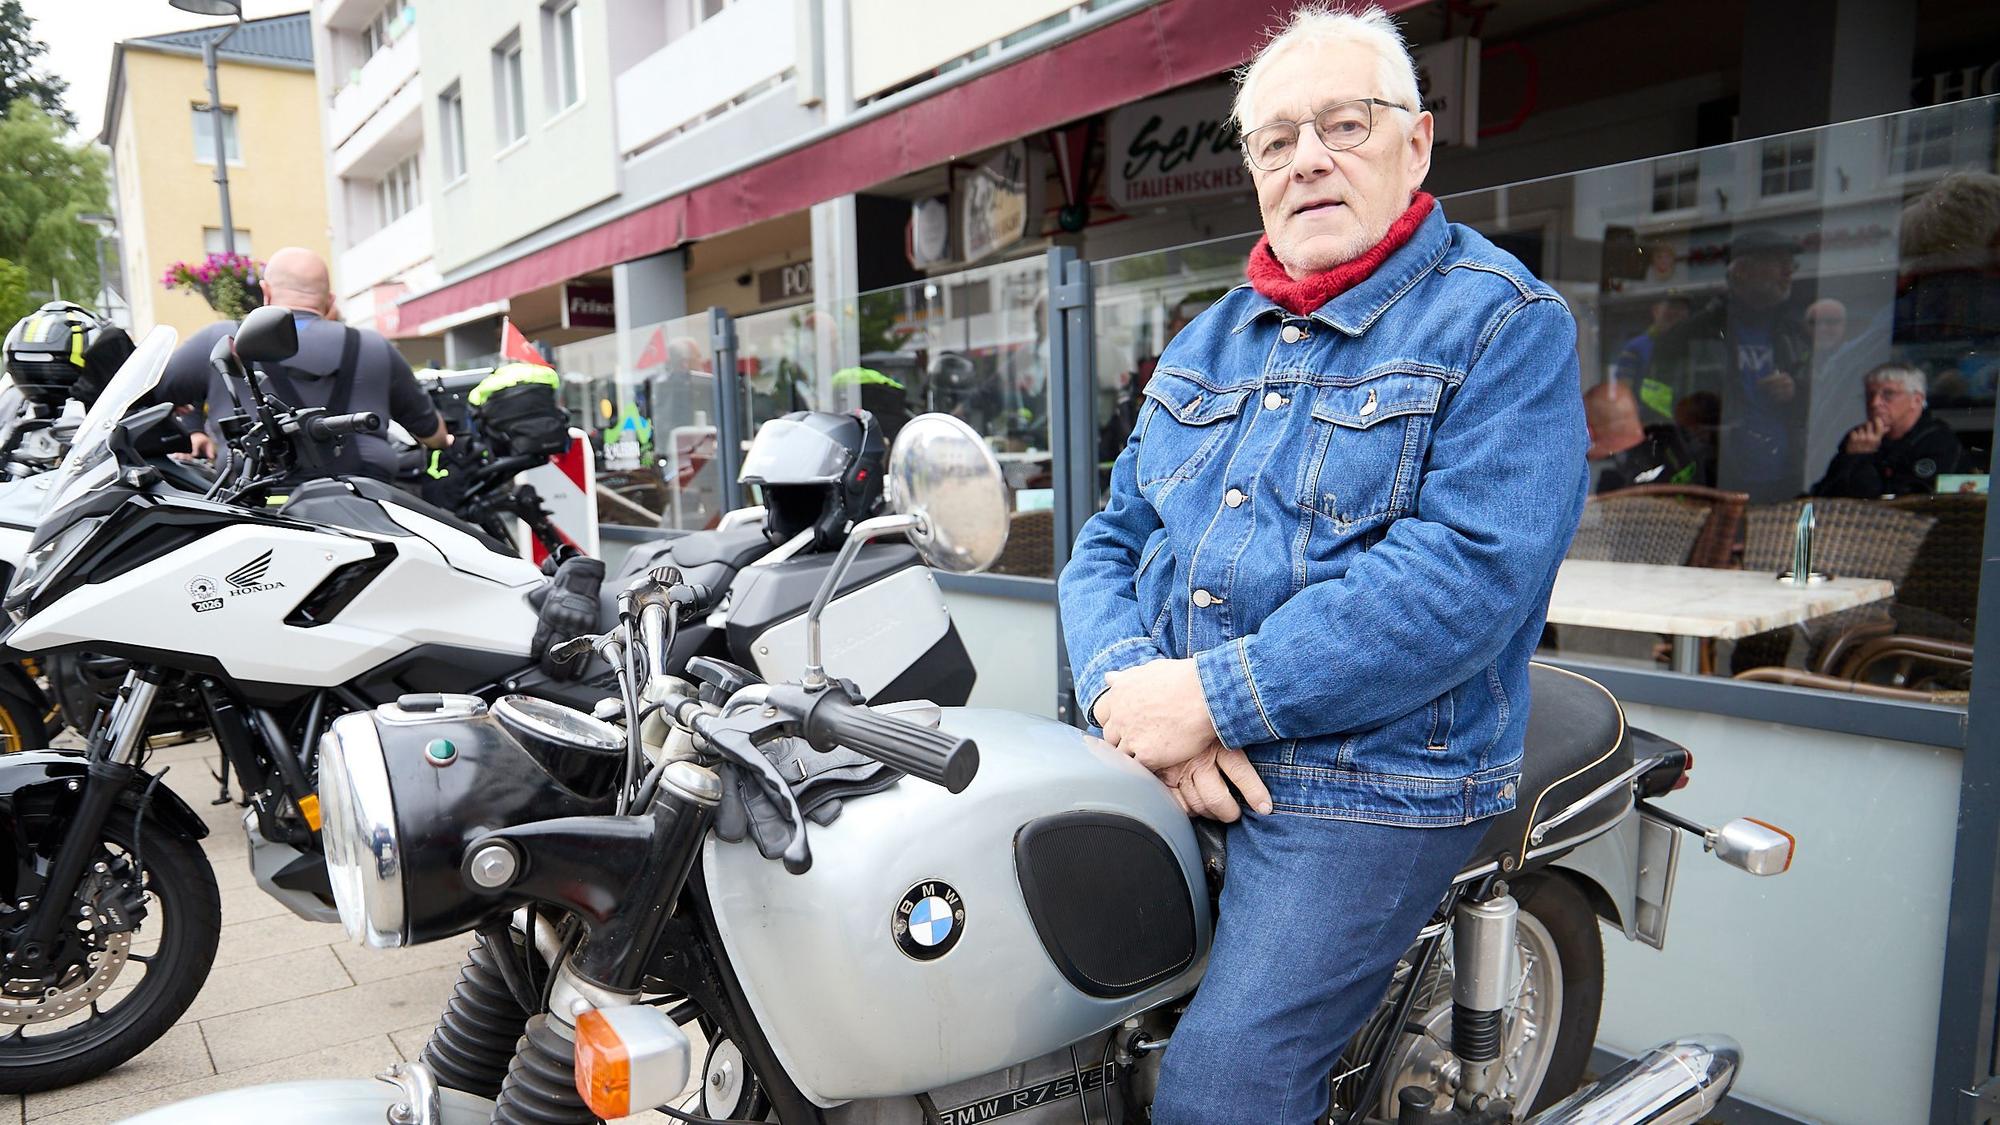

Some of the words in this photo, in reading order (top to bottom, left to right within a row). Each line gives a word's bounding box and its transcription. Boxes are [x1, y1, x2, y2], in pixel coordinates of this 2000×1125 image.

[1125, 166, 1244, 201] ITALIENISCHES
[230, 581, 286, 597] HONDA
[195, 599, 223, 612] 2026
[900, 883, 959, 915] BMW
